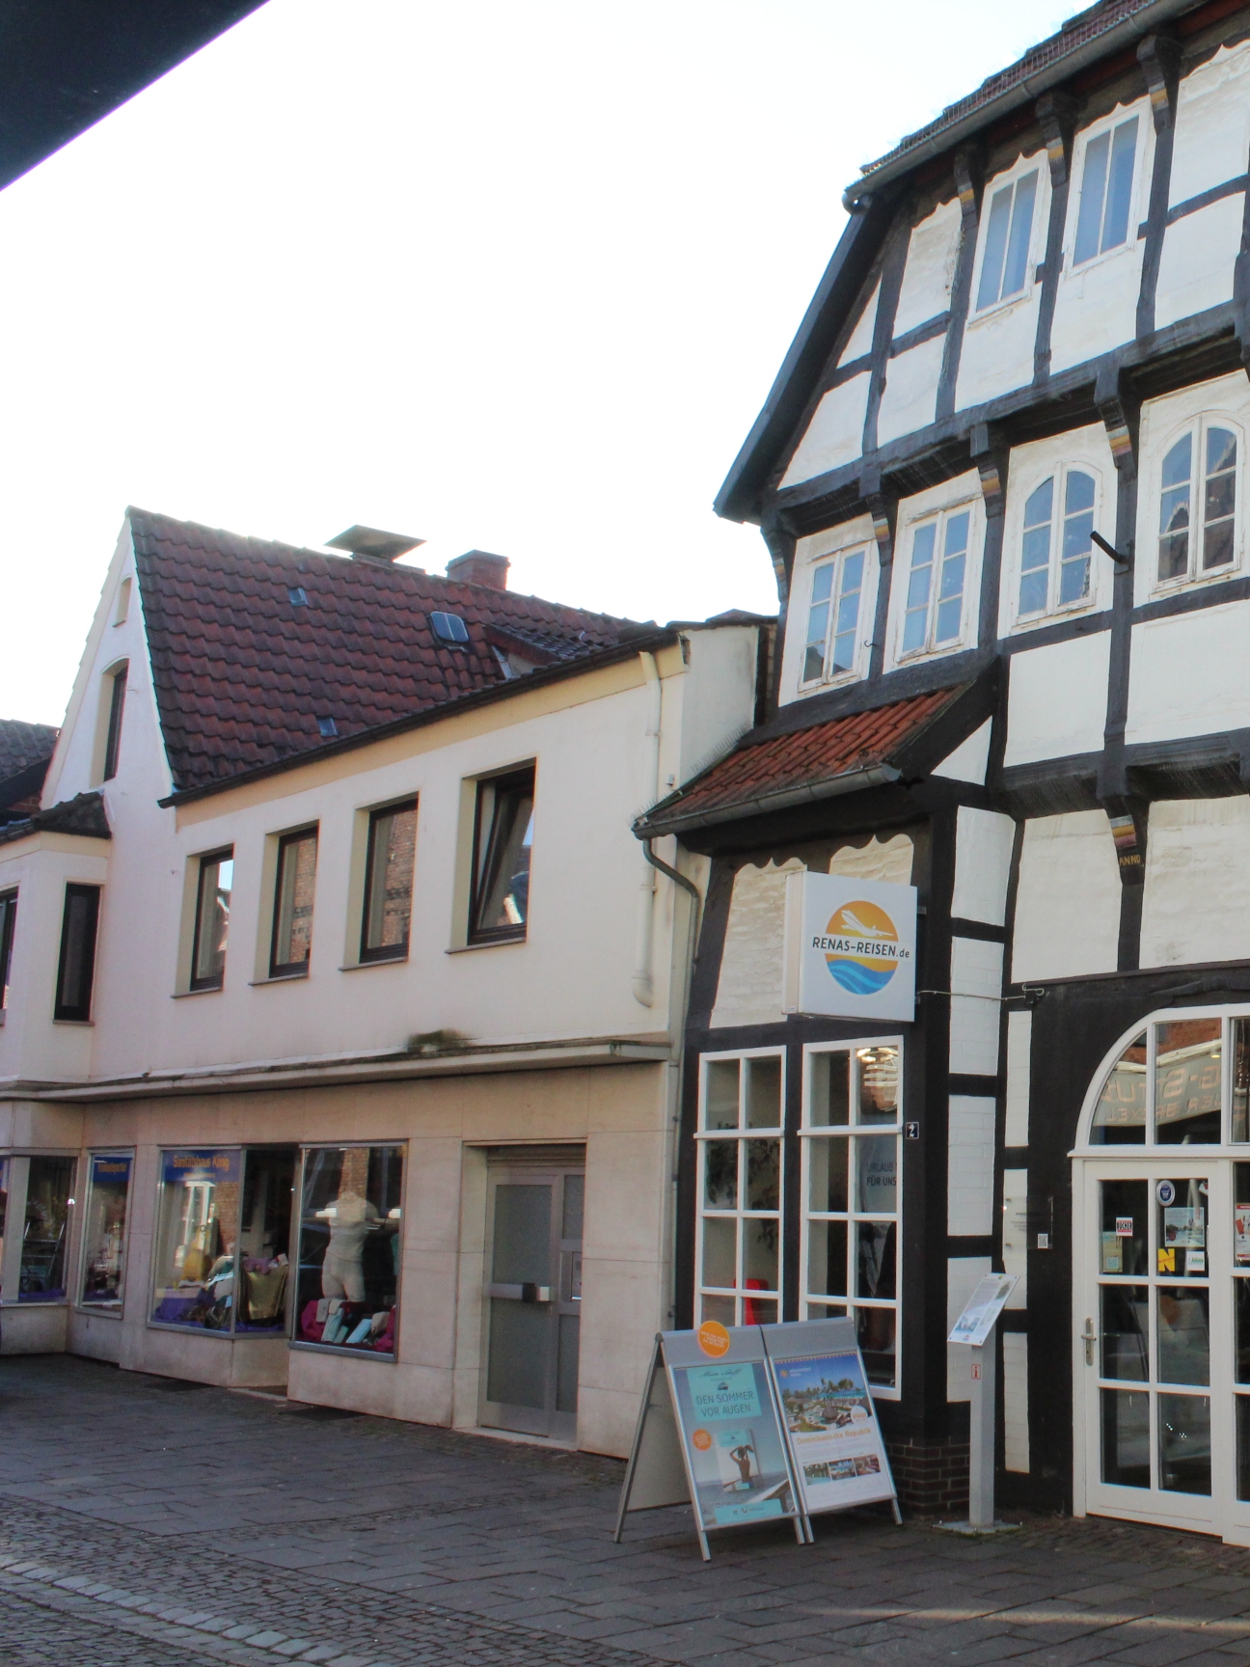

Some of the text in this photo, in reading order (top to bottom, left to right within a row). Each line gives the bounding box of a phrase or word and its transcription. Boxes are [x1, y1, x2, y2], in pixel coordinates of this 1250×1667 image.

[1118, 854, 1141, 867] ANNO
[907, 1123, 916, 1139] 2
[867, 1162, 894, 1173] URLAUB
[866, 1174, 881, 1186] FÜR
[696, 1390, 754, 1406] DEN SOMMER
[701, 1406, 720, 1417] VOR
[796, 1426, 872, 1445] Dominikanische Republik
